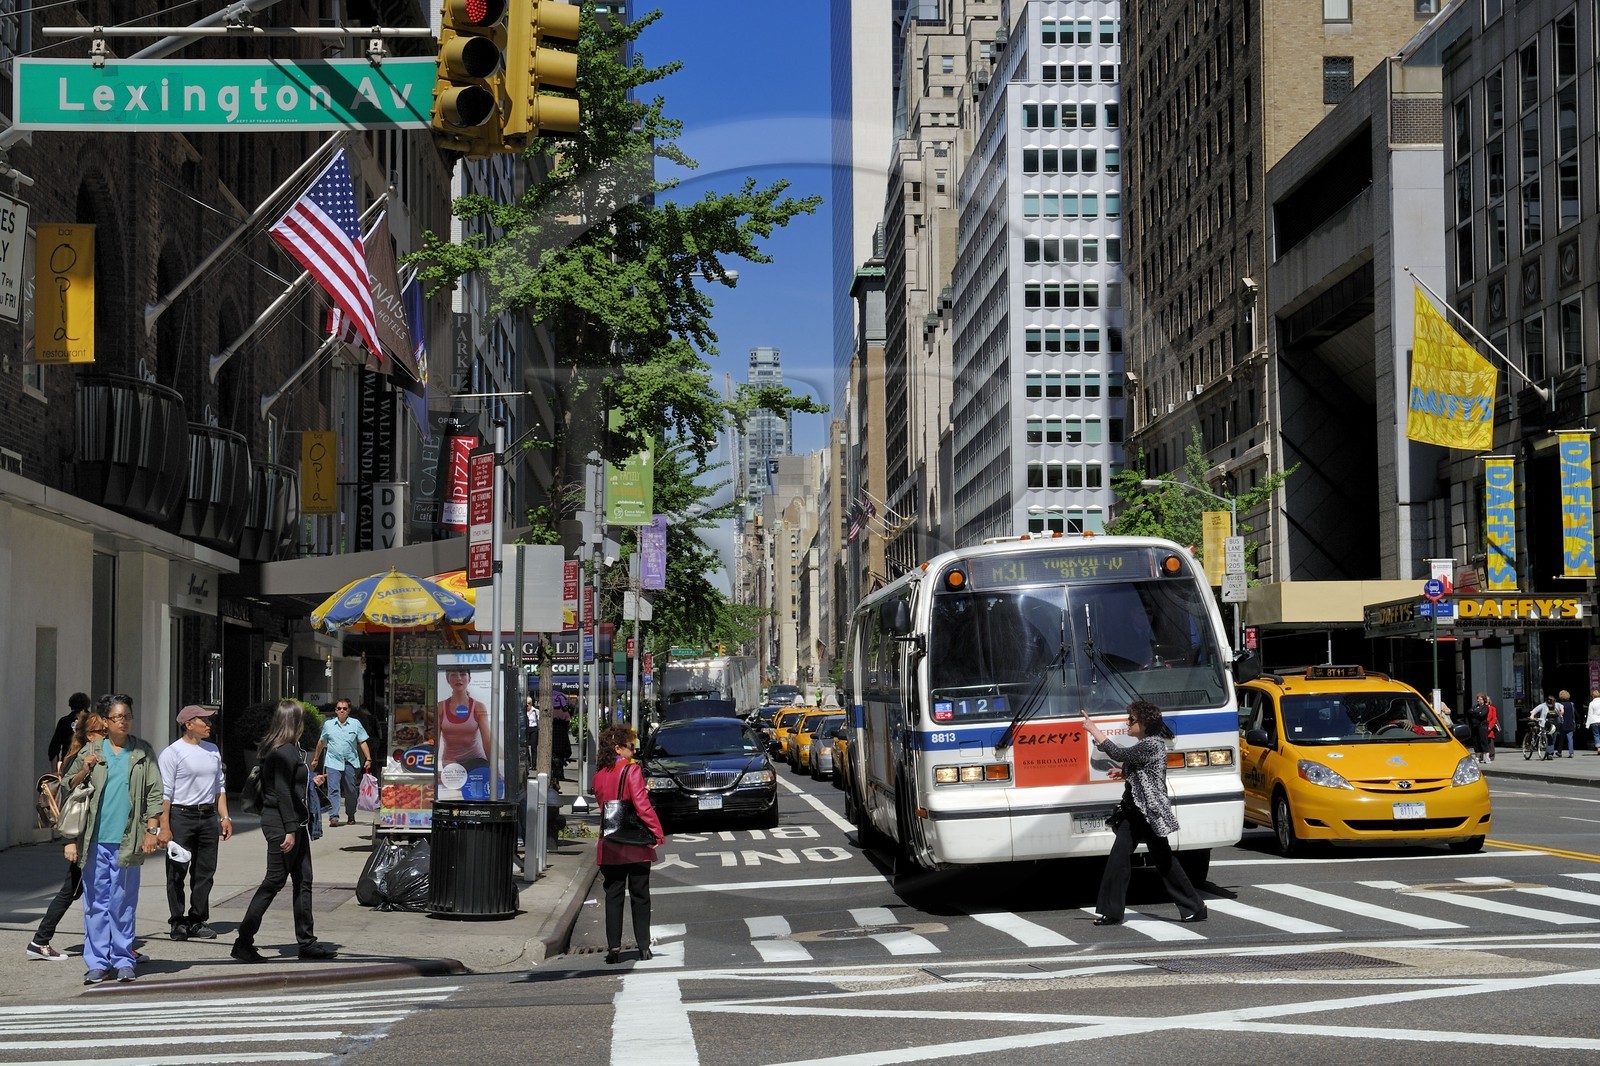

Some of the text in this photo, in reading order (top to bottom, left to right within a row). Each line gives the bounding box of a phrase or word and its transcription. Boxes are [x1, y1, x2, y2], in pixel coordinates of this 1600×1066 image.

[59, 77, 413, 123] Lexington Av
[58, 227, 73, 236] bar
[377, 309, 407, 340] HOTELS
[457, 315, 469, 368] PARK
[42, 348, 87, 359] restaurant
[362, 373, 376, 428] WALLY
[379, 399, 391, 452] WALLY
[438, 417, 459, 425] OPEN
[360, 431, 374, 499] FINDLAY
[453, 438, 474, 498] PIZZA
[1560, 440, 1595, 569] DAFFY'S
[1486, 465, 1517, 584] DAFFY'S
[476, 544, 490, 553] STANDING
[1060, 566, 1099, 579] 91 ST
[377, 587, 424, 599] SABRETT
[1458, 599, 1580, 618] DAFFY'S
[371, 611, 441, 625] SABRETT
[455, 653, 488, 663] TITAN
[959, 700, 968, 713] 1
[977, 699, 988, 712] 2
[931, 732, 956, 744] 8813
[1018, 732, 1082, 745] ZACKY'S
[1036, 757, 1078, 765] BROADWAY
[650, 846, 854, 871] ONLY
